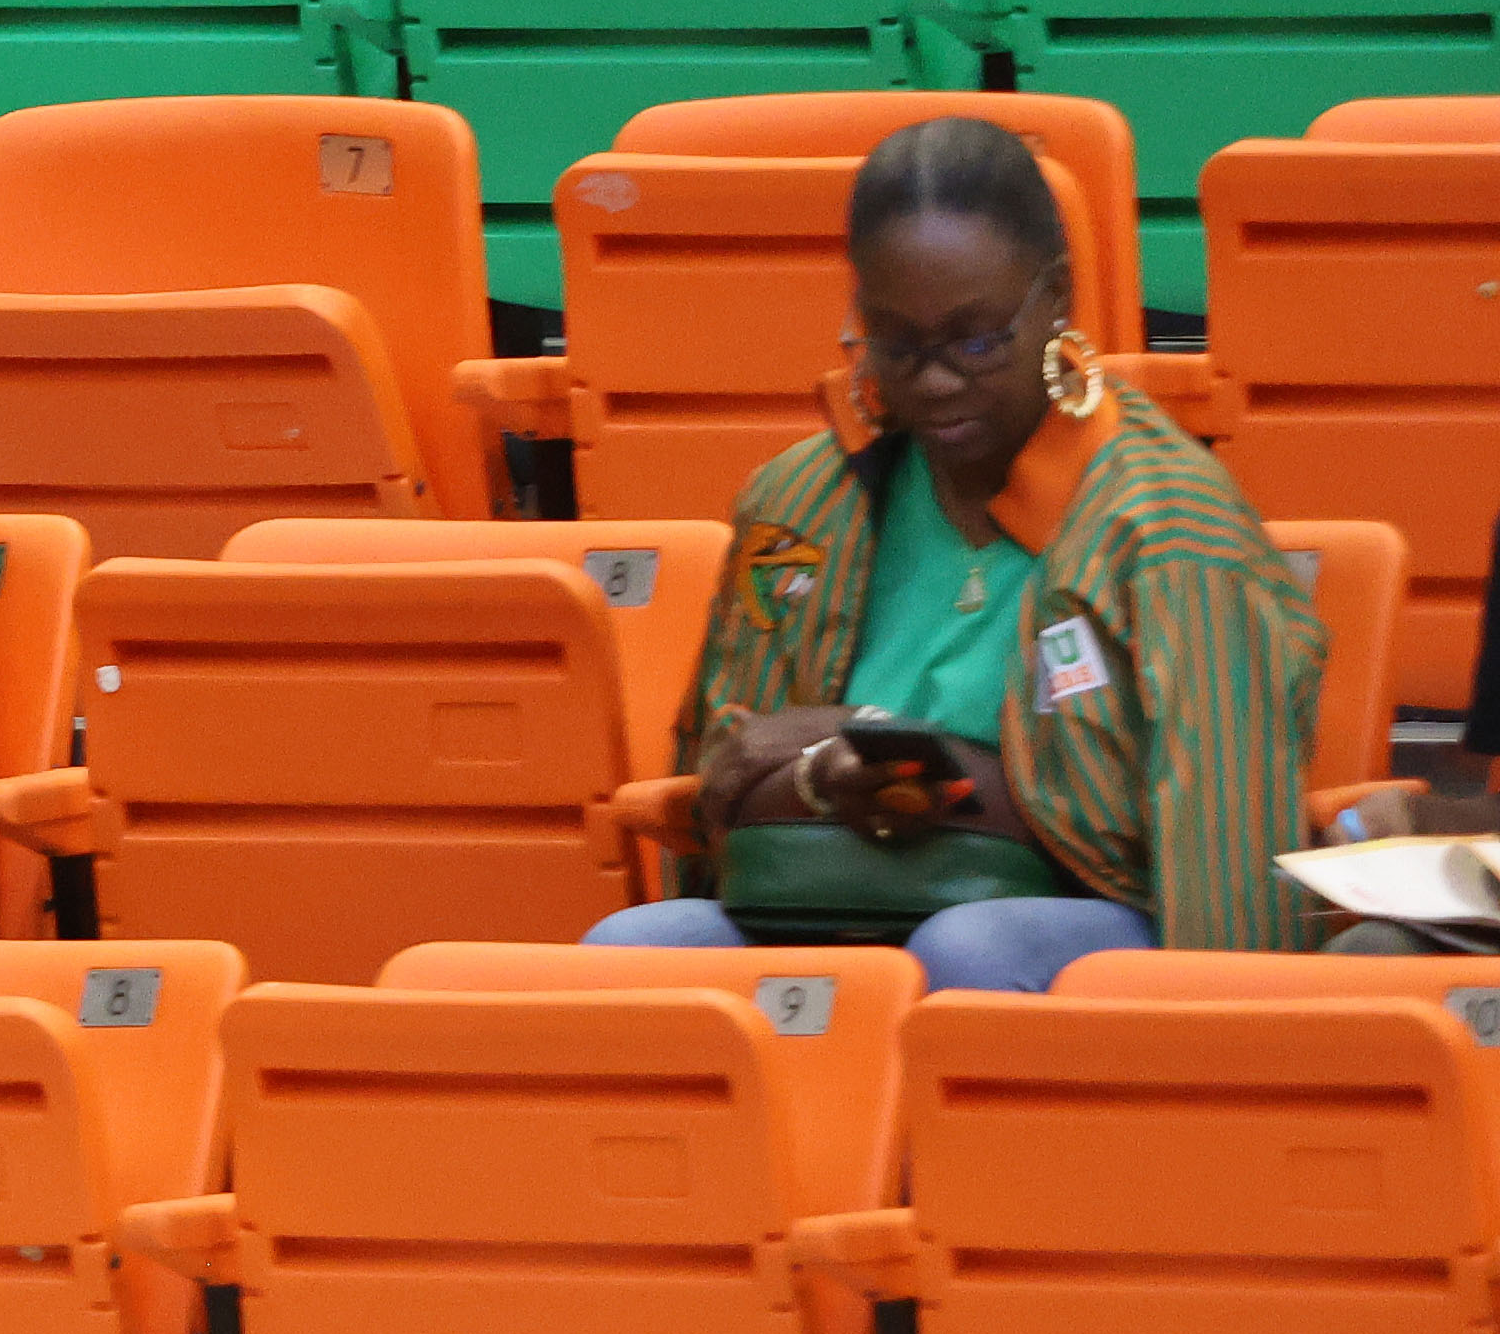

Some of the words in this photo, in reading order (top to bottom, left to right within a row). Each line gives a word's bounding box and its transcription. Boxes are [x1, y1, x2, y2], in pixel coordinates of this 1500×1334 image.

[347, 147, 365, 183] 7
[108, 979, 131, 1016] 8
[781, 986, 805, 1024] 9
